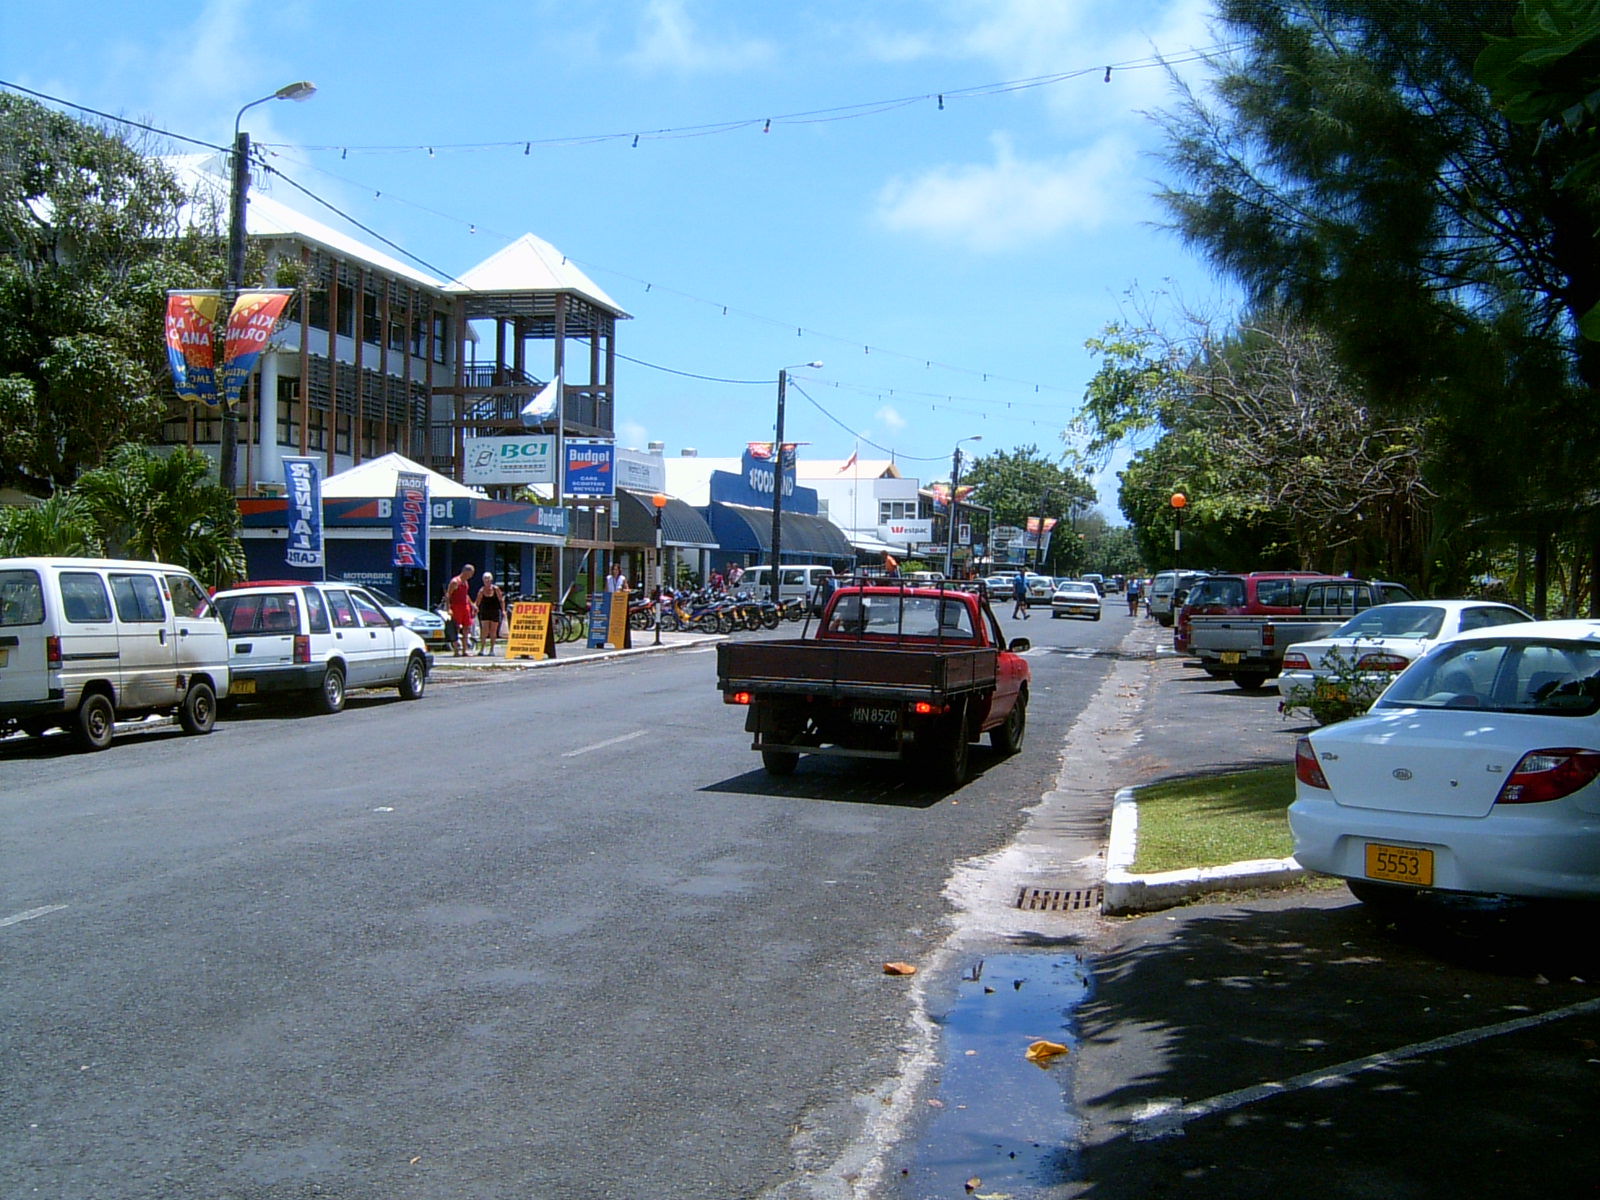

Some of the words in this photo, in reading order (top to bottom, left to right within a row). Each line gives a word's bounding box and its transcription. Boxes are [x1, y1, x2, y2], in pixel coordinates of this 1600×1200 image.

[169, 328, 210, 346] OANA
[500, 443, 548, 459] BCI
[569, 449, 610, 465] Budget
[538, 507, 564, 532] Budget
[891, 525, 928, 534] Westpac
[343, 572, 393, 580] MOTORBIKE
[516, 604, 547, 615] OPEN
[1377, 852, 1419, 876] 5553
